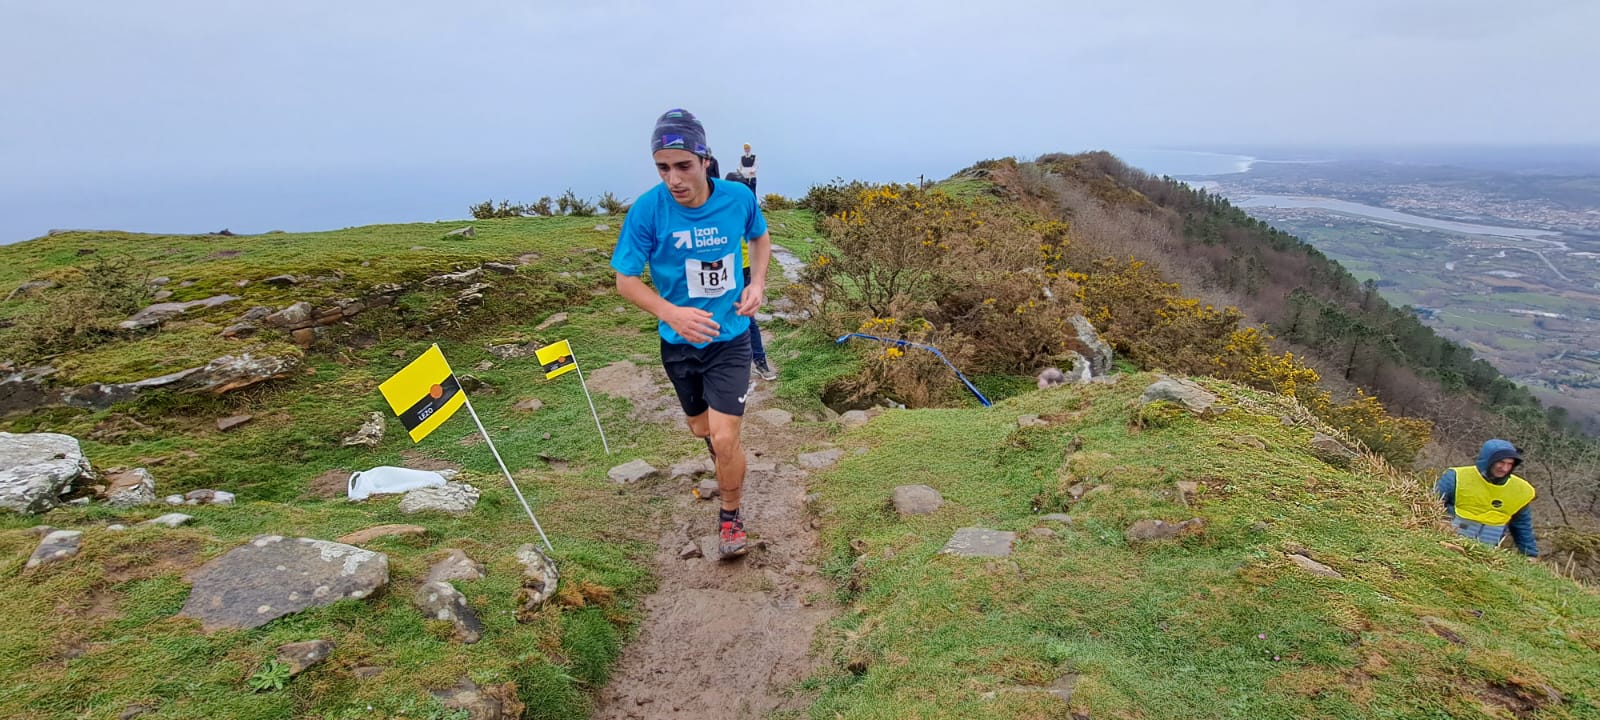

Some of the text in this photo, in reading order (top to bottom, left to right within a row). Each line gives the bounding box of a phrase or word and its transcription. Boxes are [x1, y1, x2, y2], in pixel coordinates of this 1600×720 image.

[695, 236, 728, 248] bidea
[698, 267, 728, 286] 184
[418, 407, 434, 421] LEZO
